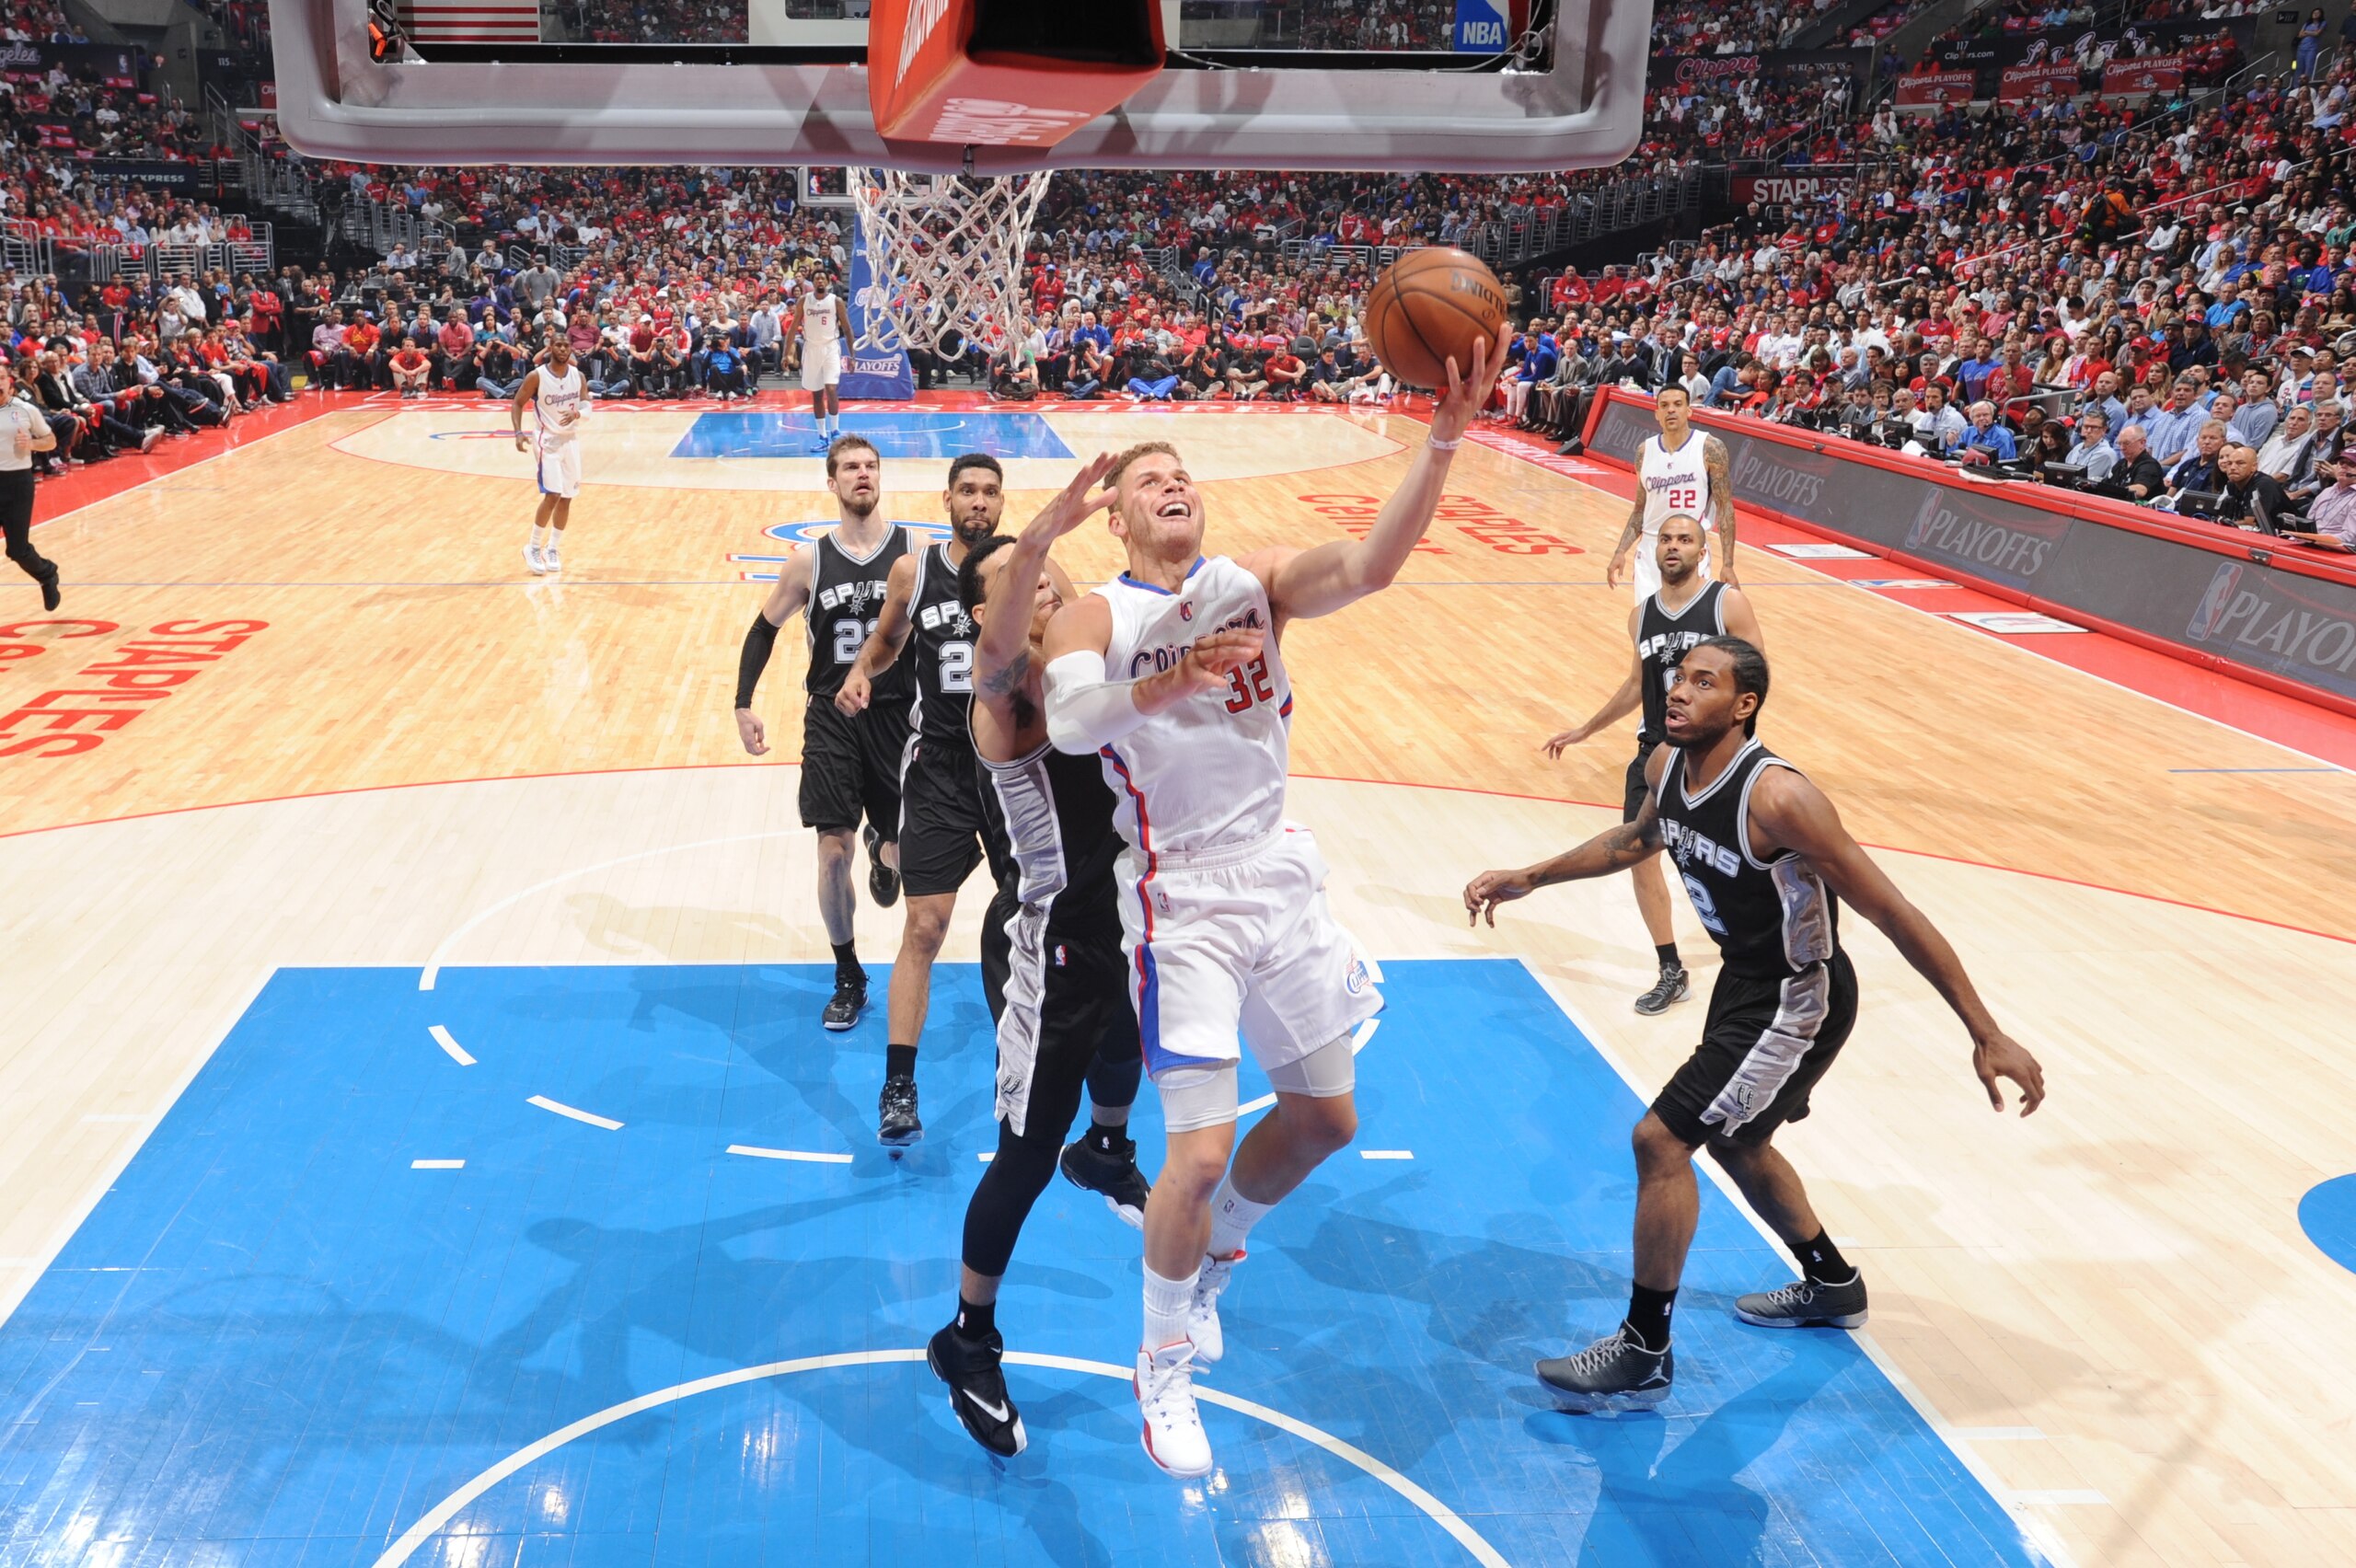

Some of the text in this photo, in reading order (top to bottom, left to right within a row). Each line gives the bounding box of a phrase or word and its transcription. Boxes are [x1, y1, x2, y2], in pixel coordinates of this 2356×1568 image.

[1462, 21, 1502, 45] NBA
[1945, 49, 1994, 61] Cliprs.com
[1956, 41, 1969, 51] 117
[217, 57, 230, 66] 115
[1675, 55, 1761, 84] Clippers
[2107, 57, 2183, 76] Clippers PLAYOFFS
[1899, 73, 1972, 89] Clippers PLAYOFFS
[2004, 65, 2078, 83] Clippers PLAYOFFS
[821, 317, 827, 326] 6
[854, 361, 900, 372] LAYOFFS
[545, 391, 581, 407] Clippers
[1606, 420, 1657, 451] PLAYO
[1646, 472, 1697, 494] Clippers
[1738, 456, 1826, 507] PLAYOFFS
[1669, 490, 1695, 508] 22
[1922, 509, 2052, 575] PLAYOFFS
[819, 580, 887, 617] SPUR
[834, 618, 880, 664] 2
[2212, 590, 2356, 673] PLAYO
[939, 640, 974, 693] 2
[1225, 650, 1274, 714] 32
[1682, 871, 1729, 936] 2
